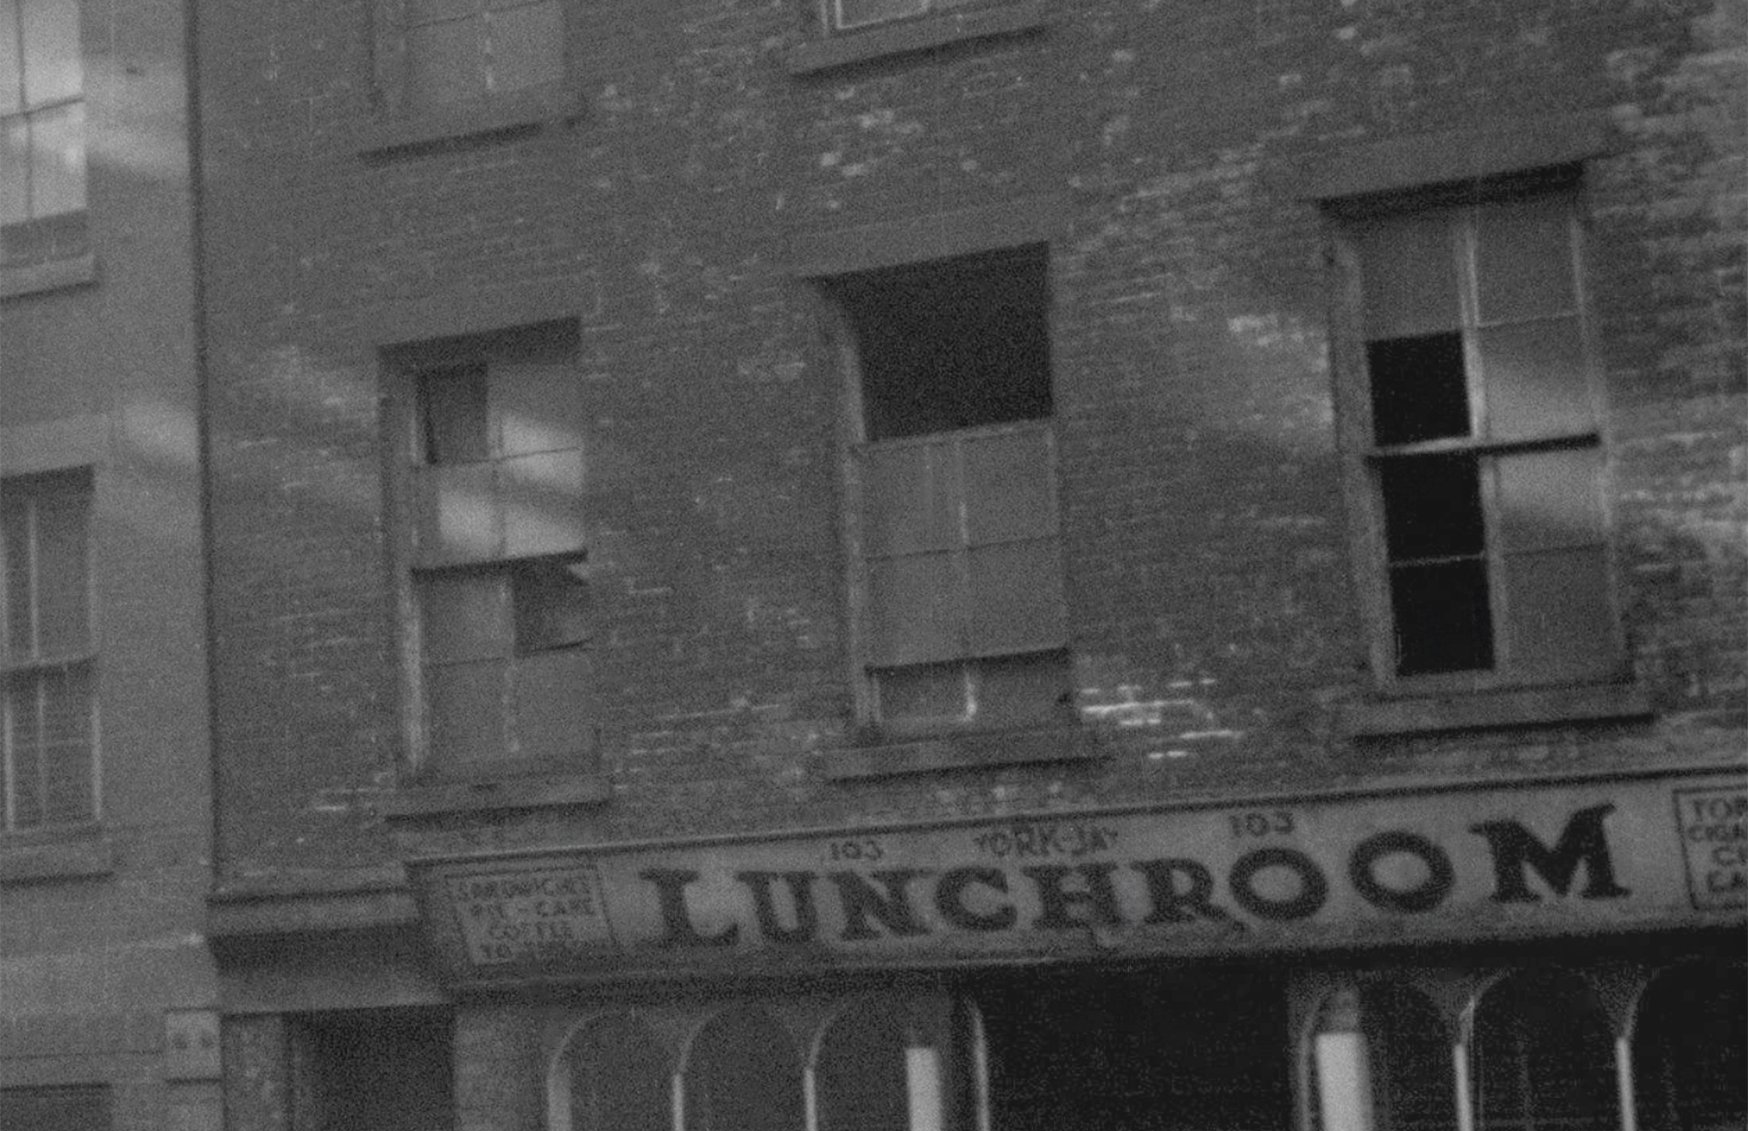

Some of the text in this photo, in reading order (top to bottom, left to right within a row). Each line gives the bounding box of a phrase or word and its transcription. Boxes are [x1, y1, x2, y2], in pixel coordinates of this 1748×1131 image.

[1228, 811, 1295, 838] 103
[829, 838, 884, 861] 103
[638, 804, 1632, 948] LUNCHROOM
